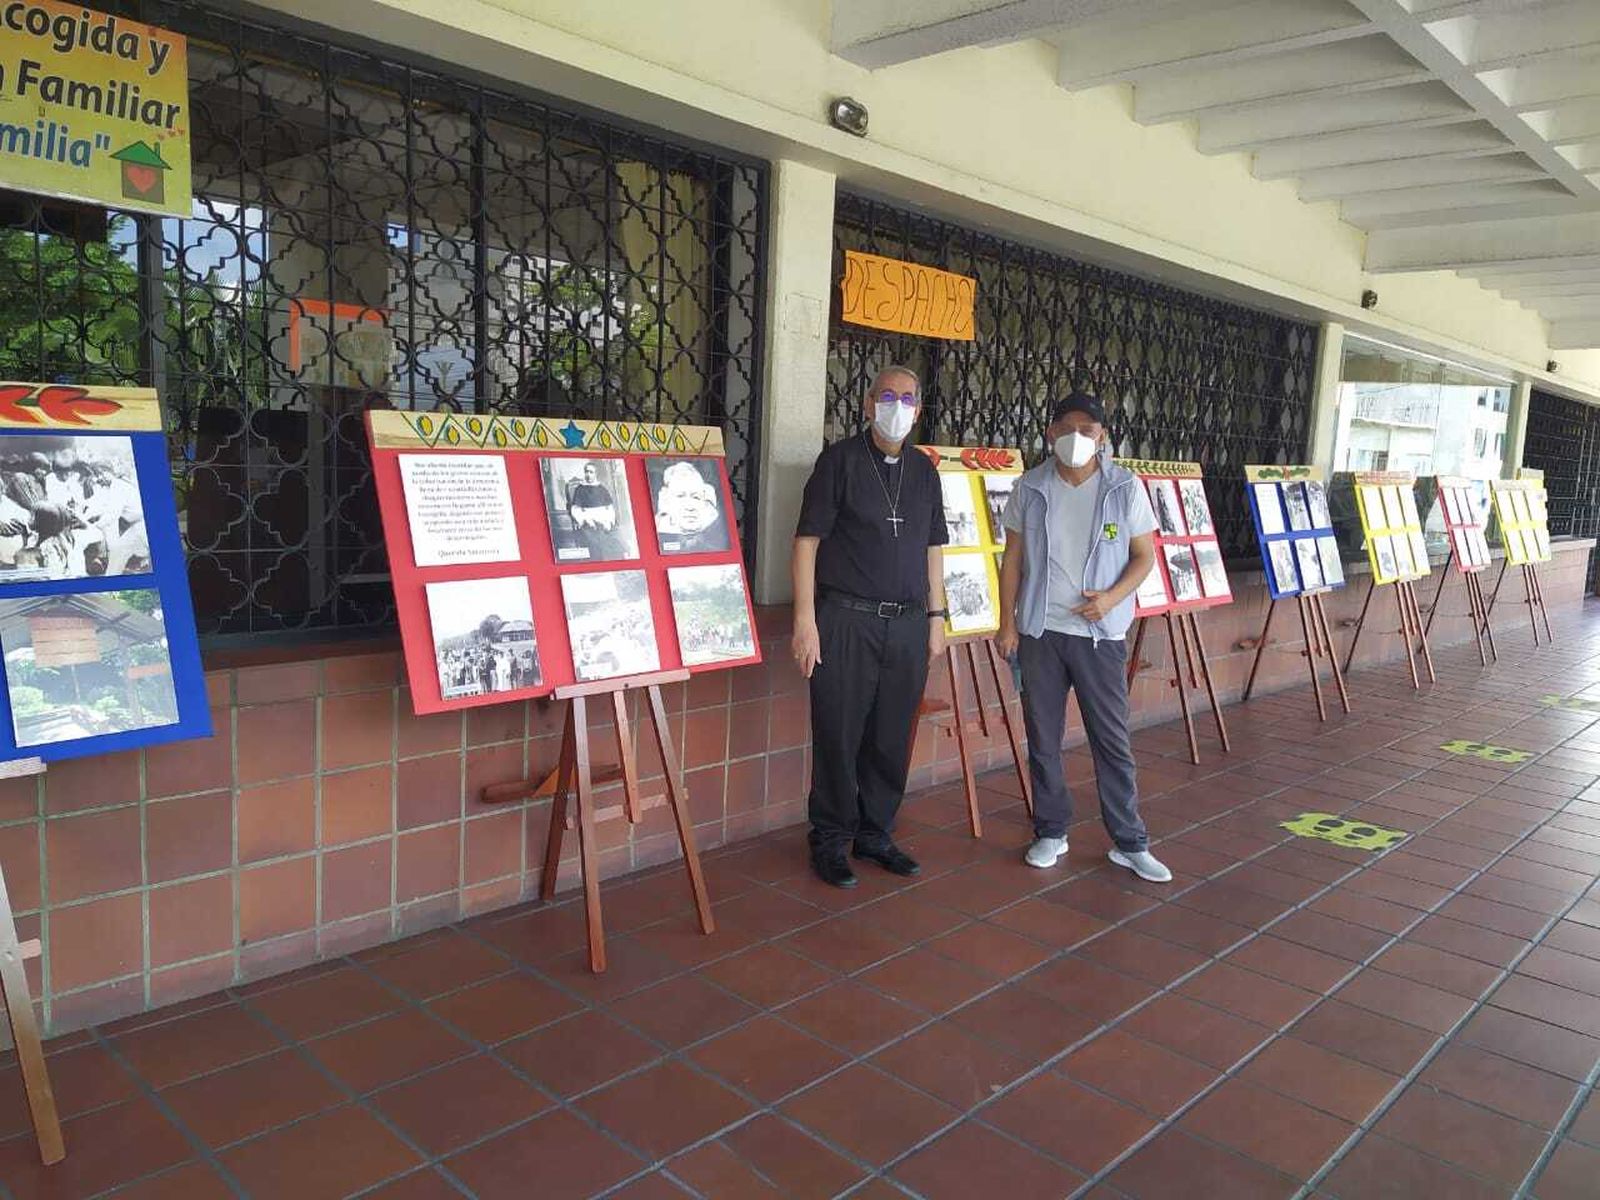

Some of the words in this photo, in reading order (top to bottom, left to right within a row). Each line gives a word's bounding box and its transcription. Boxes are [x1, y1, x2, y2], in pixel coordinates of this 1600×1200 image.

[0, 3, 139, 60] cogida
[149, 39, 170, 75] y
[17, 59, 180, 129] Familiar
[844, 257, 972, 333] DESPACHO
